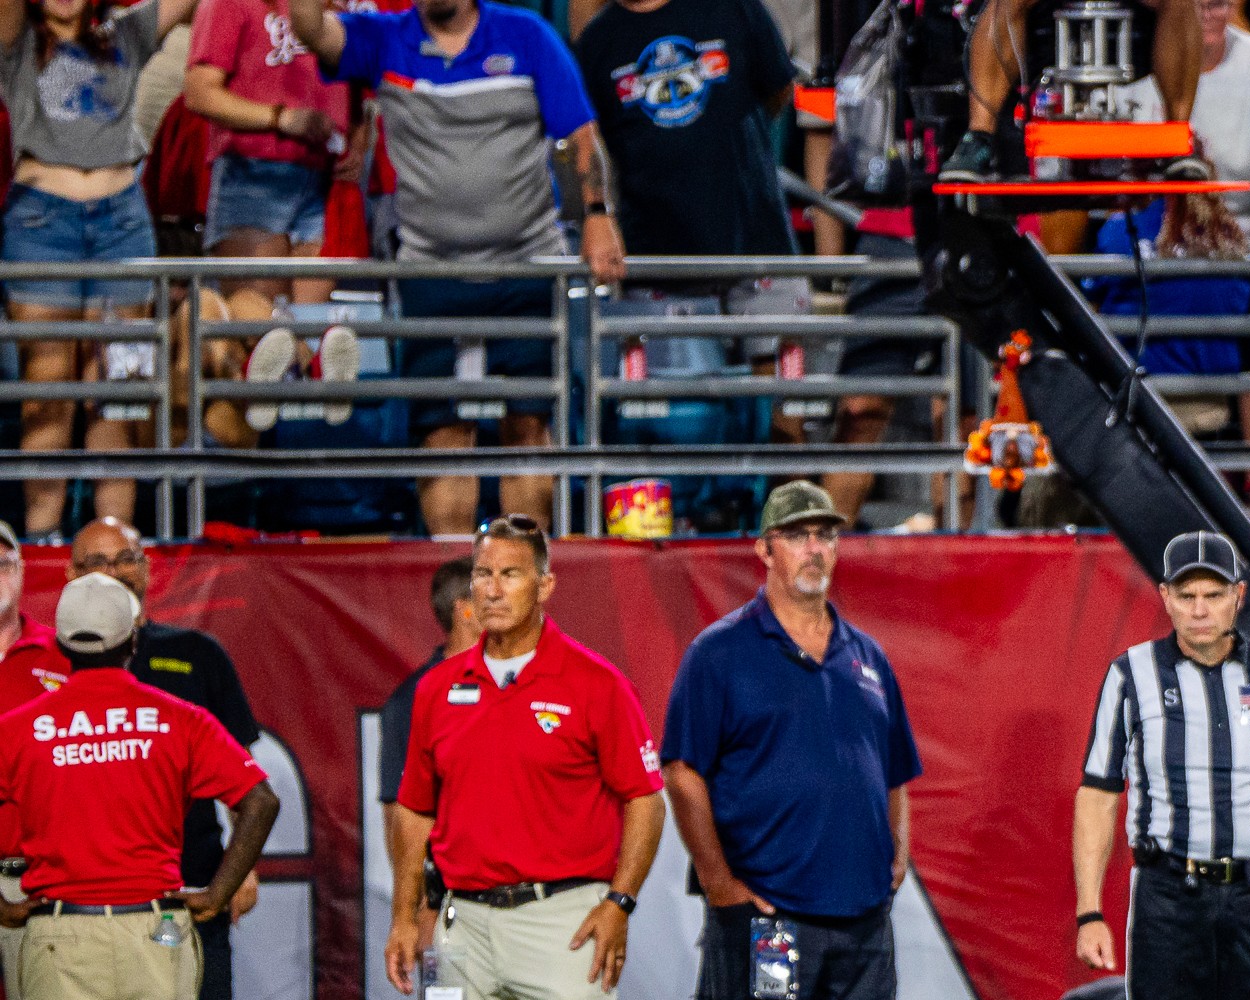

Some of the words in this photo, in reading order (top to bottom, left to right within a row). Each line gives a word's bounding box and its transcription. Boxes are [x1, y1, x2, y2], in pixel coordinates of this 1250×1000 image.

[1164, 688, 1180, 707] S
[33, 706, 171, 742] S.A.F.E.
[52, 738, 153, 767] SECURITY
